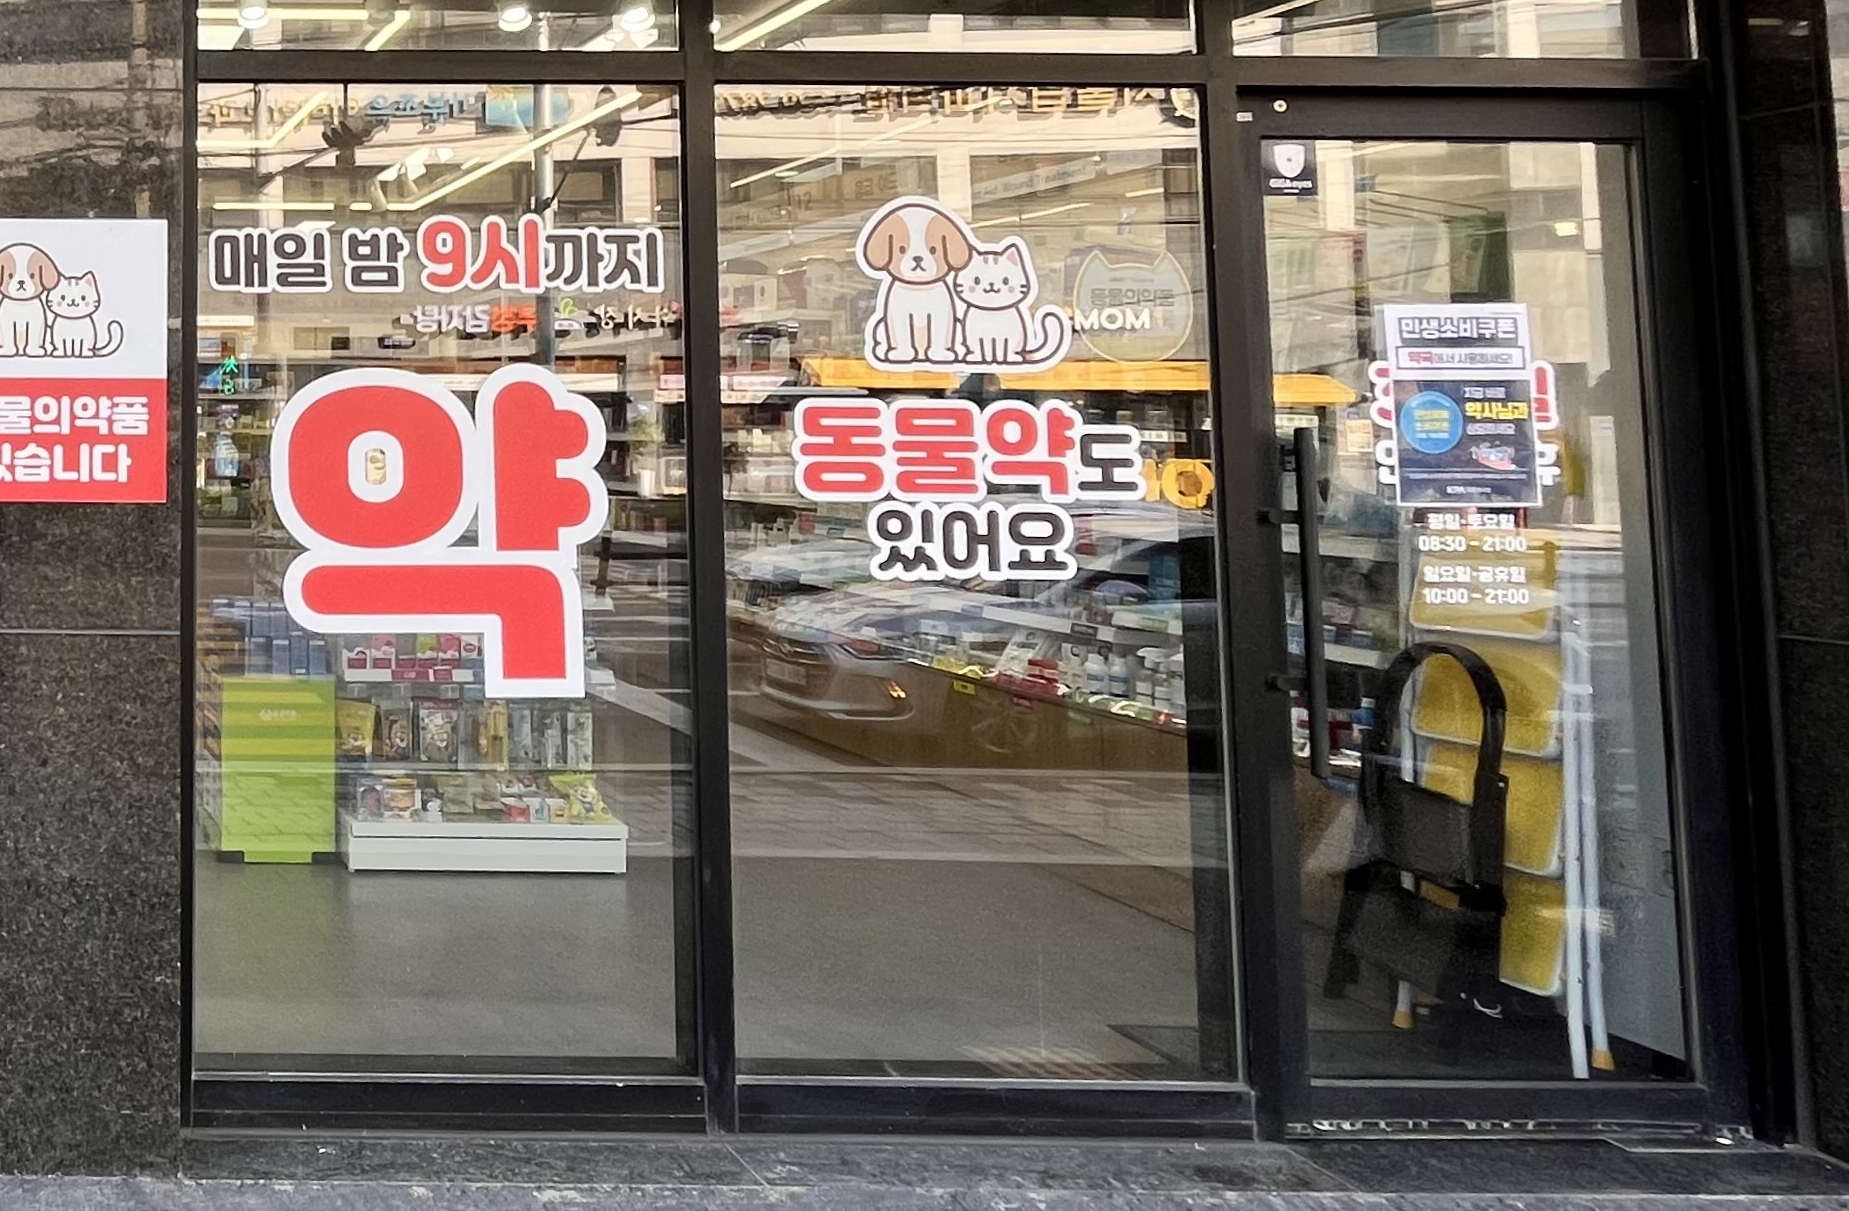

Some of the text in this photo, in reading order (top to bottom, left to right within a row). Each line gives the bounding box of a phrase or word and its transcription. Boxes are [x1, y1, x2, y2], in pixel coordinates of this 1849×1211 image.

[213, 218, 659, 290] 매일 밤 9시까지
[1400, 317, 1517, 339] 민생소비쿠폰
[799, 404, 1140, 495] 동물약도
[287, 380, 592, 680] 약
[875, 507, 1071, 573] 있어요
[1417, 535, 1467, 552] 08:30
[1482, 535, 1528, 552] 21:00
[1421, 587, 1469, 604] 10:00
[1484, 588, 1530, 604] 21:00
